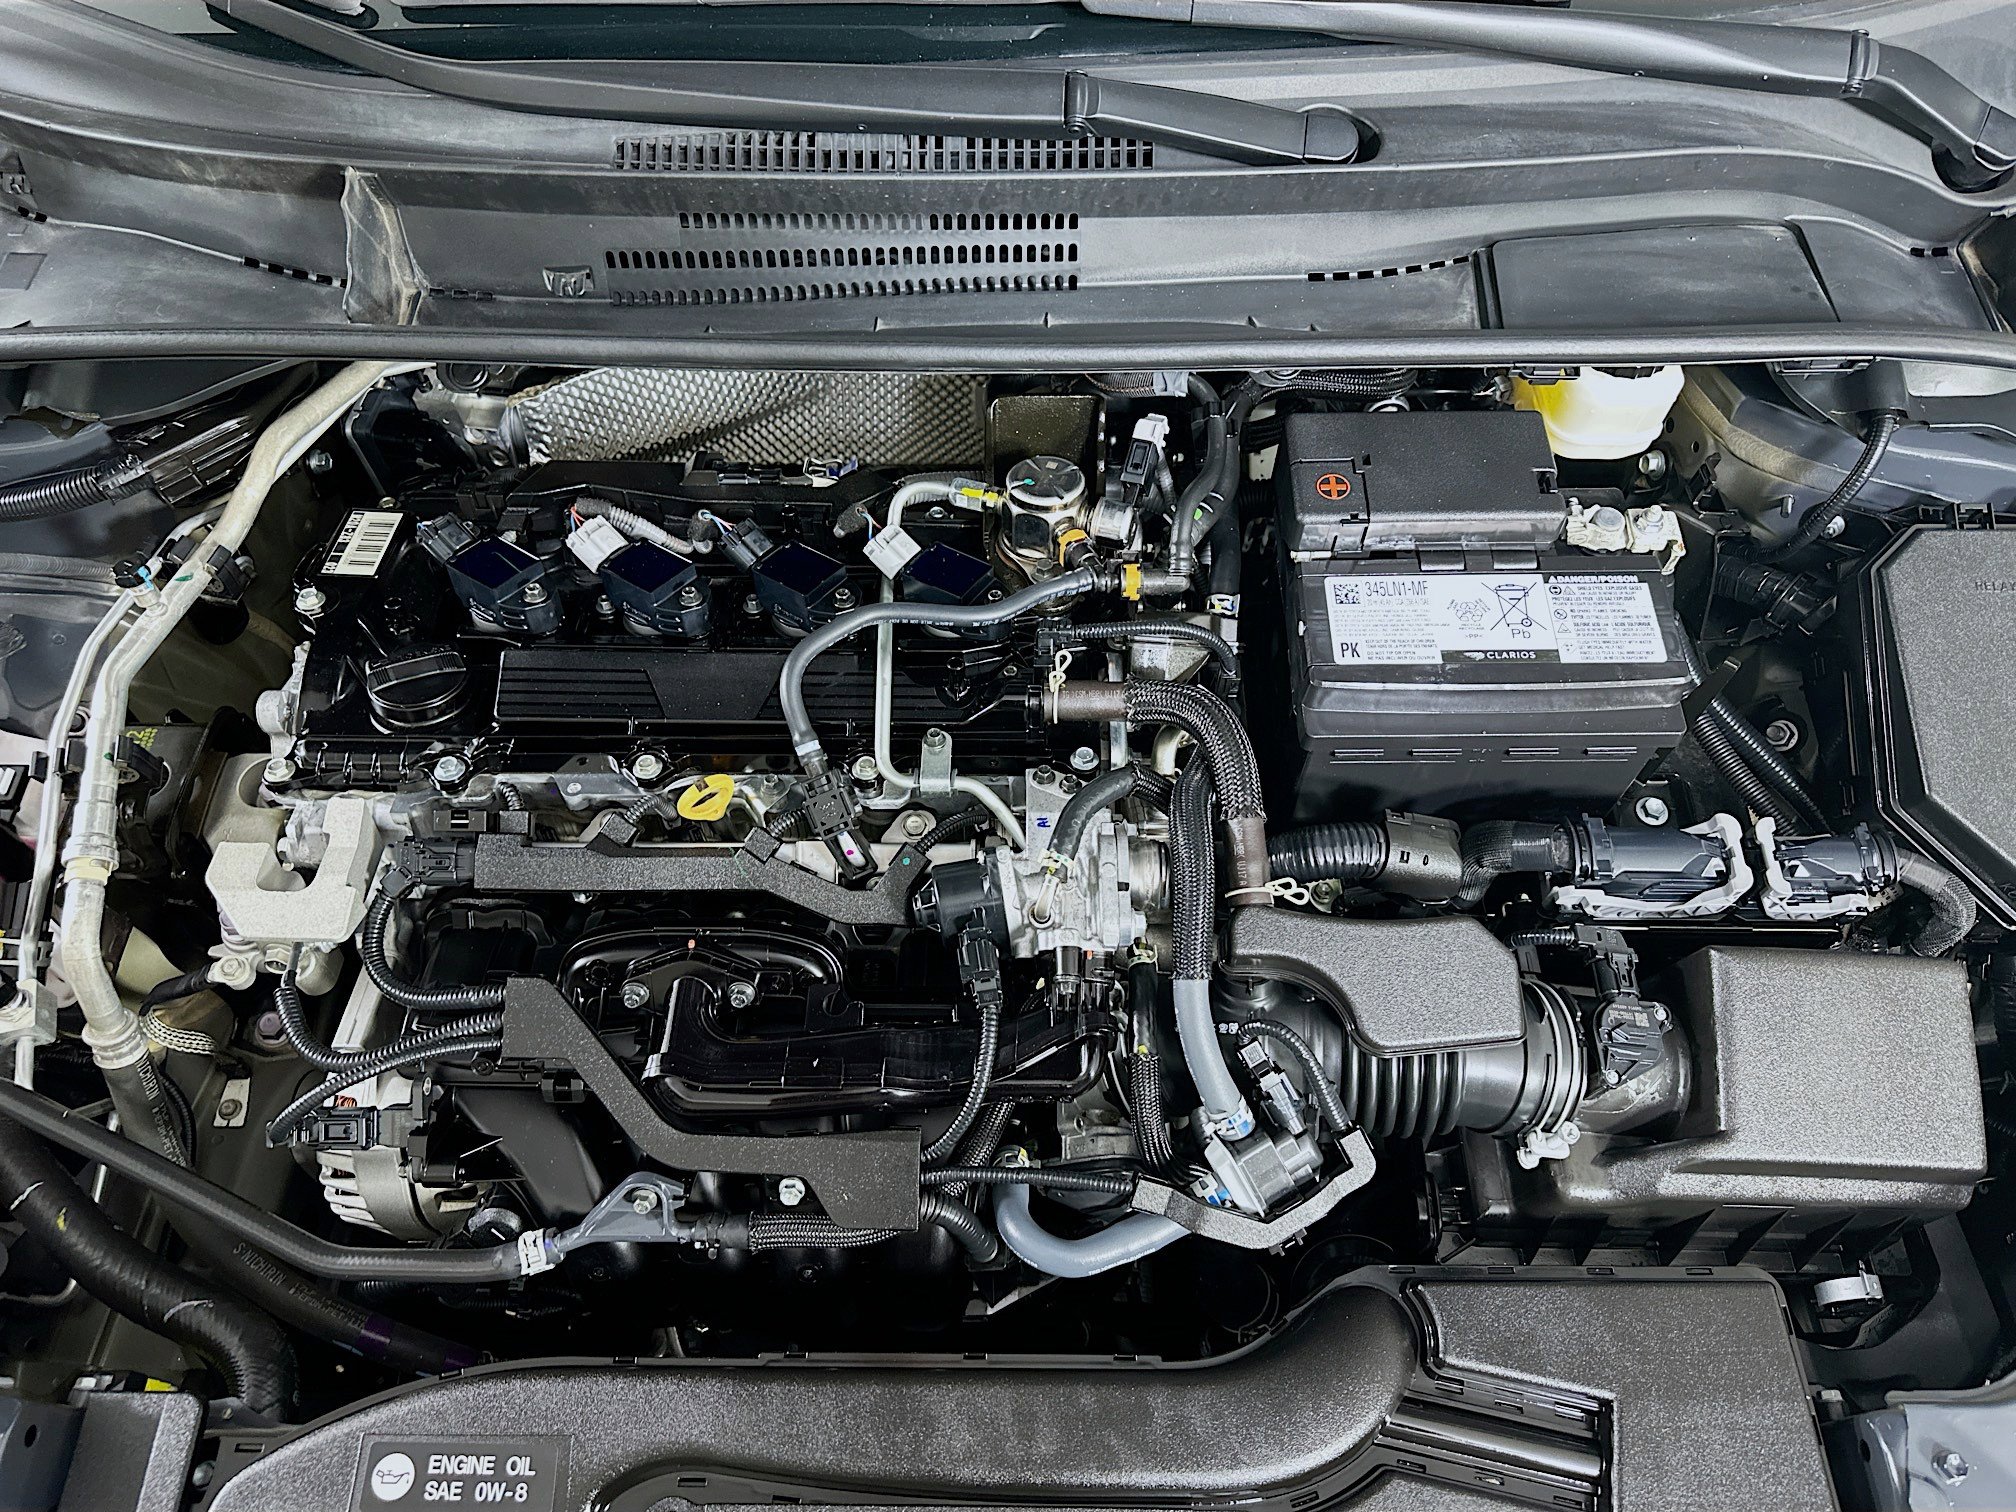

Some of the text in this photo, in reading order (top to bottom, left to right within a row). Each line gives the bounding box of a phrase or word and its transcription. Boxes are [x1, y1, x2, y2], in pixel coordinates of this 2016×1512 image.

[1364, 580, 1429, 597] 345LN1-MF
[1511, 628, 1531, 639] Pb
[1340, 642, 1361, 658] PK
[1486, 651, 1537, 659] CLARIOS
[427, 1454, 537, 1477] ENGINE OIL
[423, 1481, 529, 1503] SAE 0W-8
